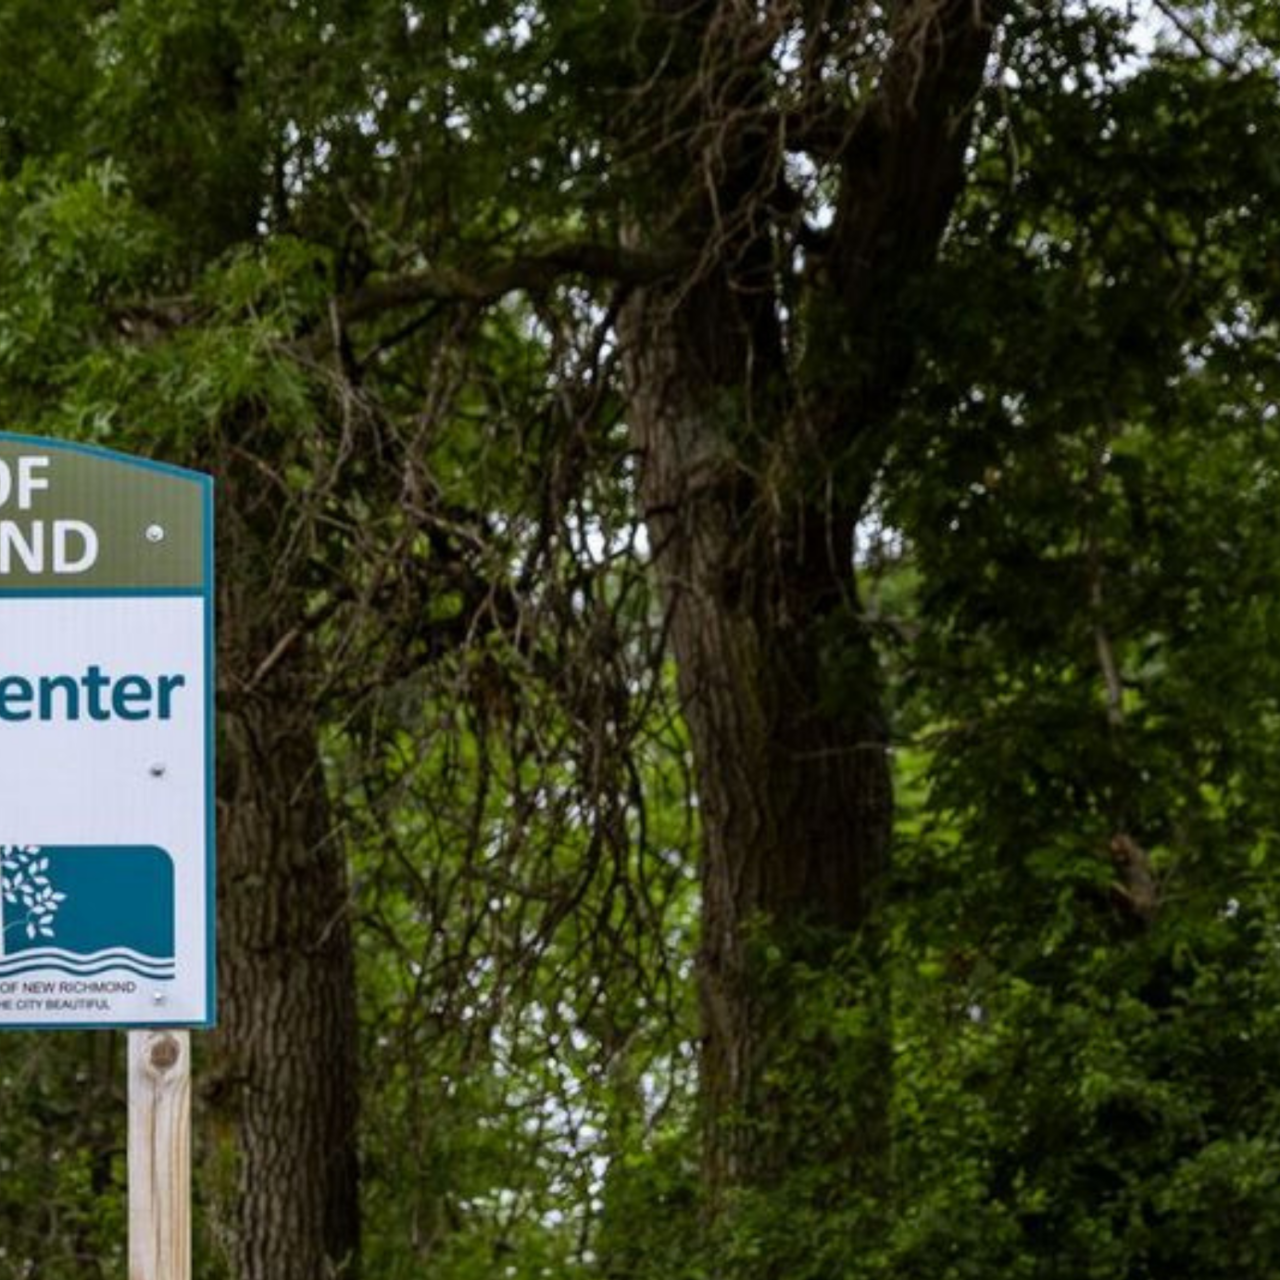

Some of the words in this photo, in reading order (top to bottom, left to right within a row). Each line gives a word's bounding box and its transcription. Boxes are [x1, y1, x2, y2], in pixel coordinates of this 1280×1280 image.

[0, 981, 18, 995] OF
[22, 981, 55, 995] NEW
[59, 980, 138, 994] RICHMOND
[16, 999, 43, 1011] CITY
[45, 999, 111, 1011] BEAUTIFUL
